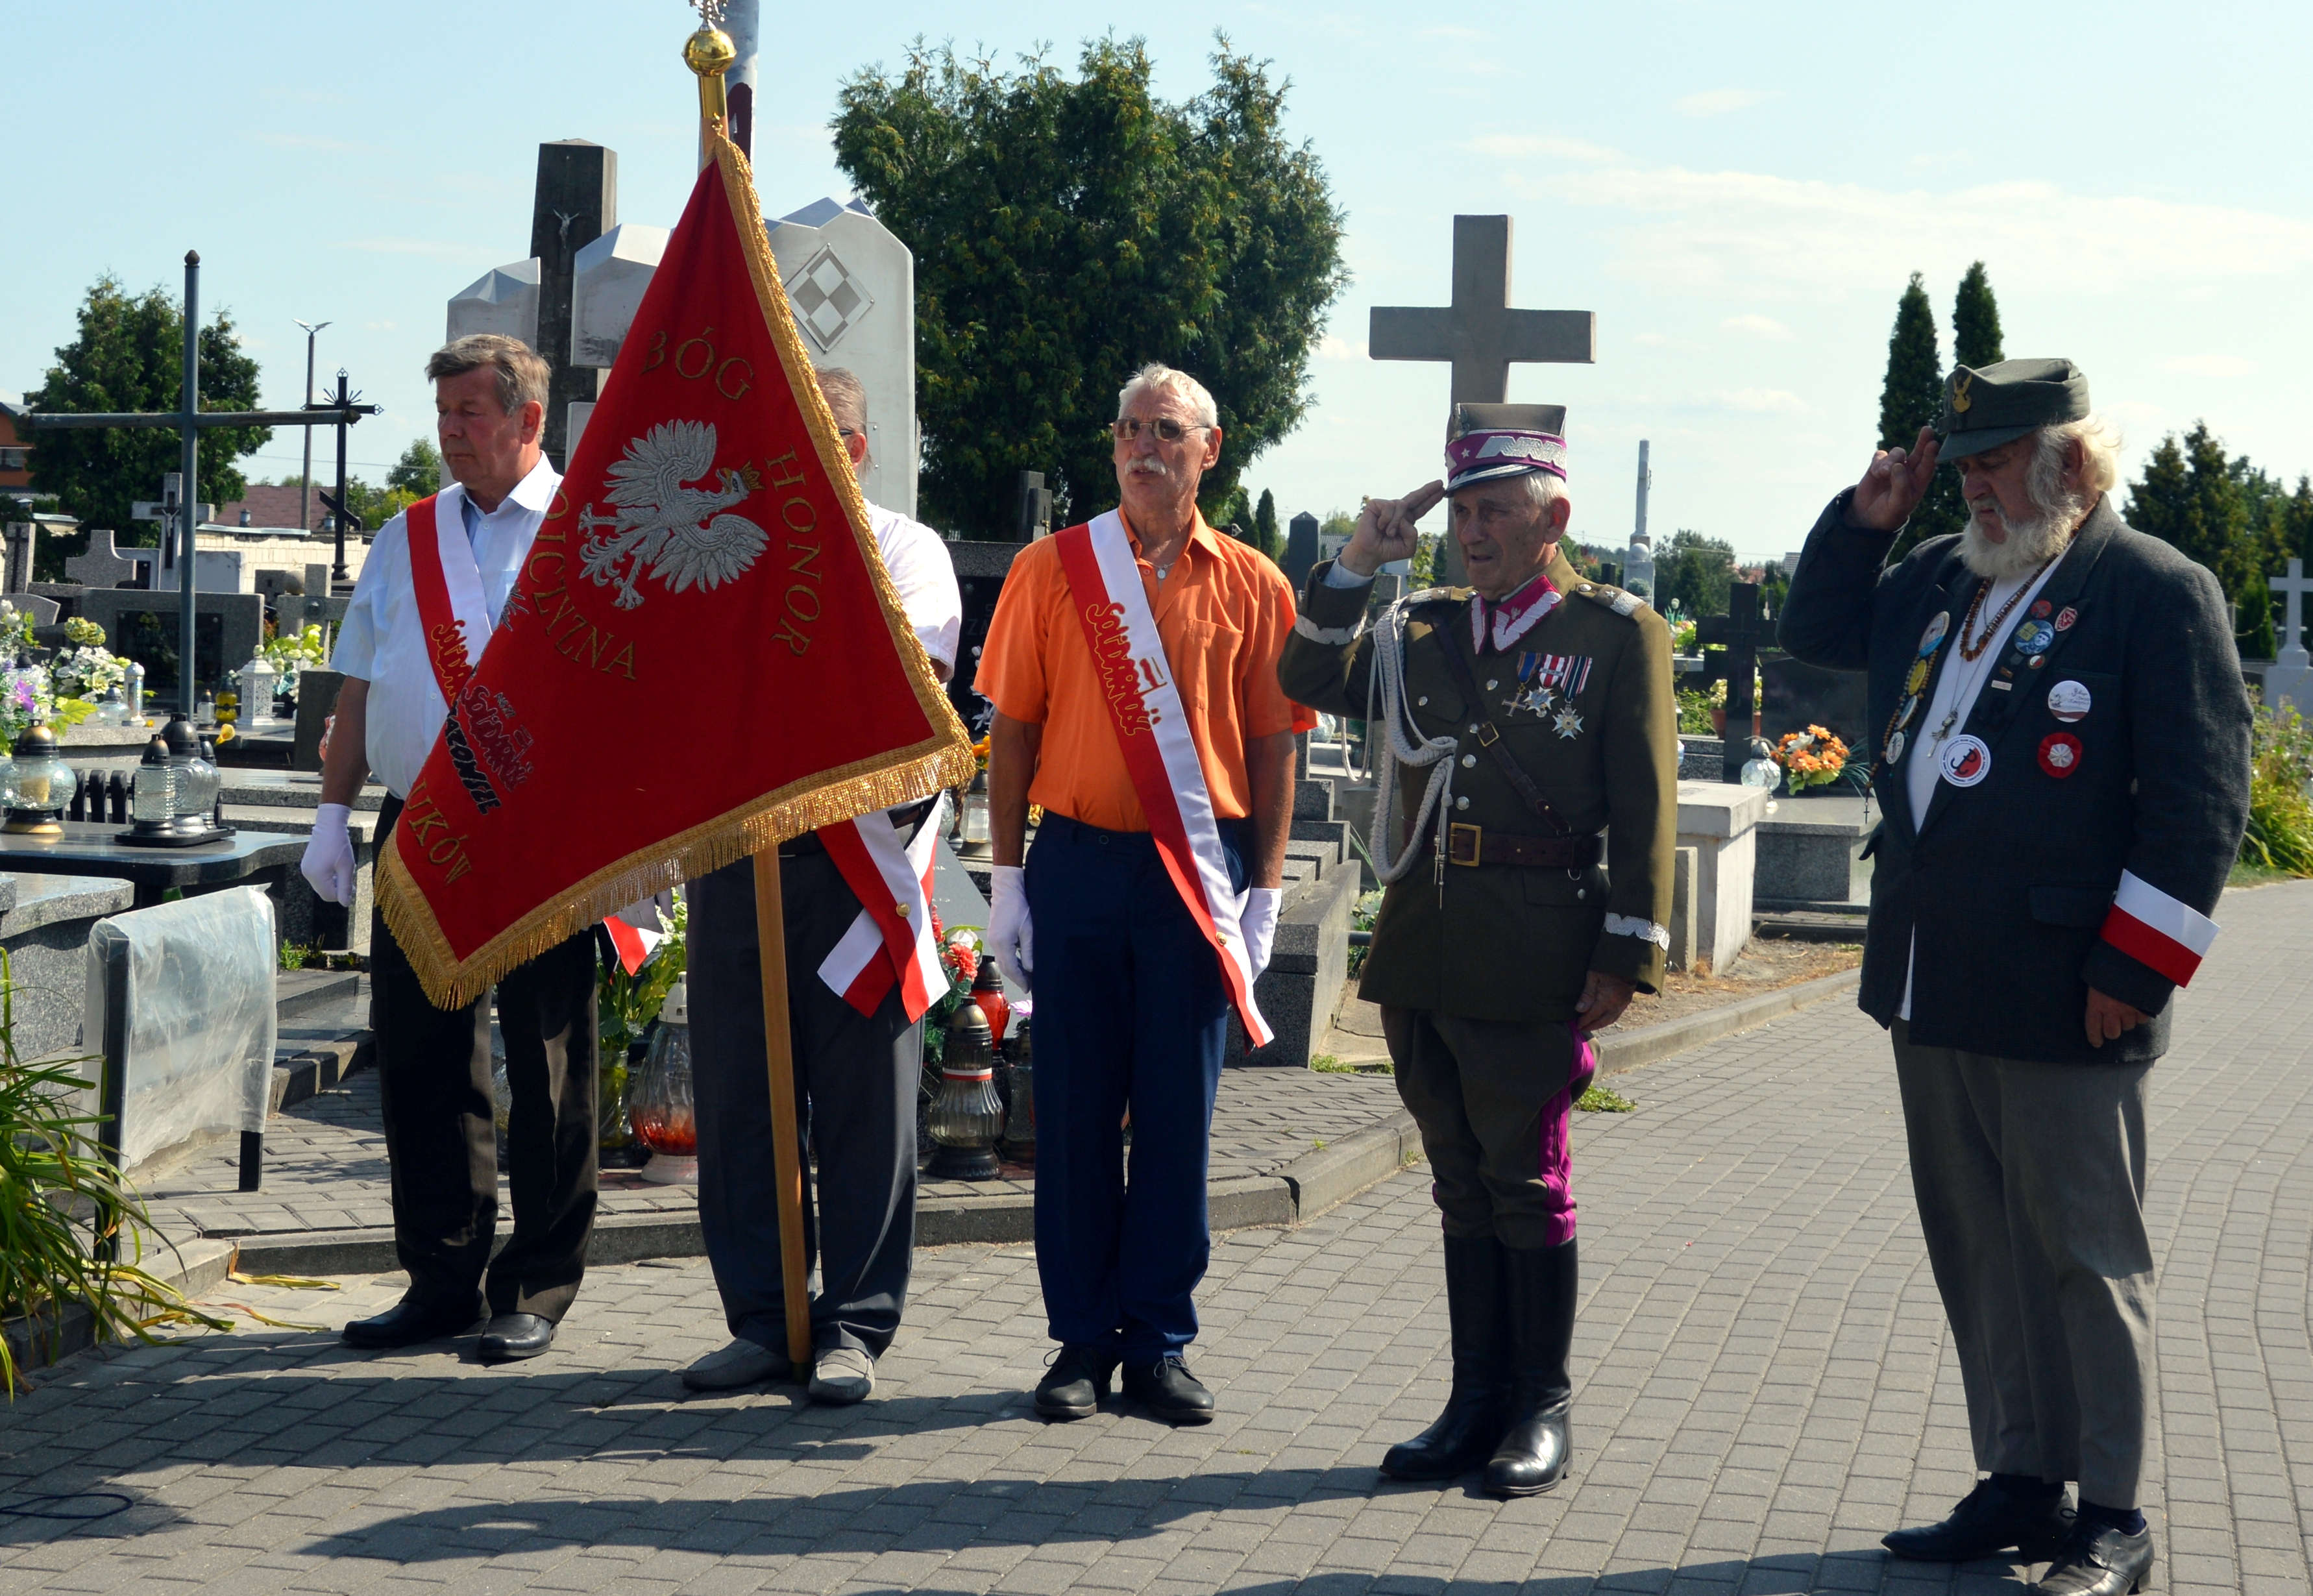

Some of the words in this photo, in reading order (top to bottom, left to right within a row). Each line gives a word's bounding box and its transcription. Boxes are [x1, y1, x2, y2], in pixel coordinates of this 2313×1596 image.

[641, 327, 754, 400] BÓG
[765, 445, 822, 657] HONOR
[445, 700, 502, 815] AZOWSZE
[406, 778, 472, 885] UKÓW
